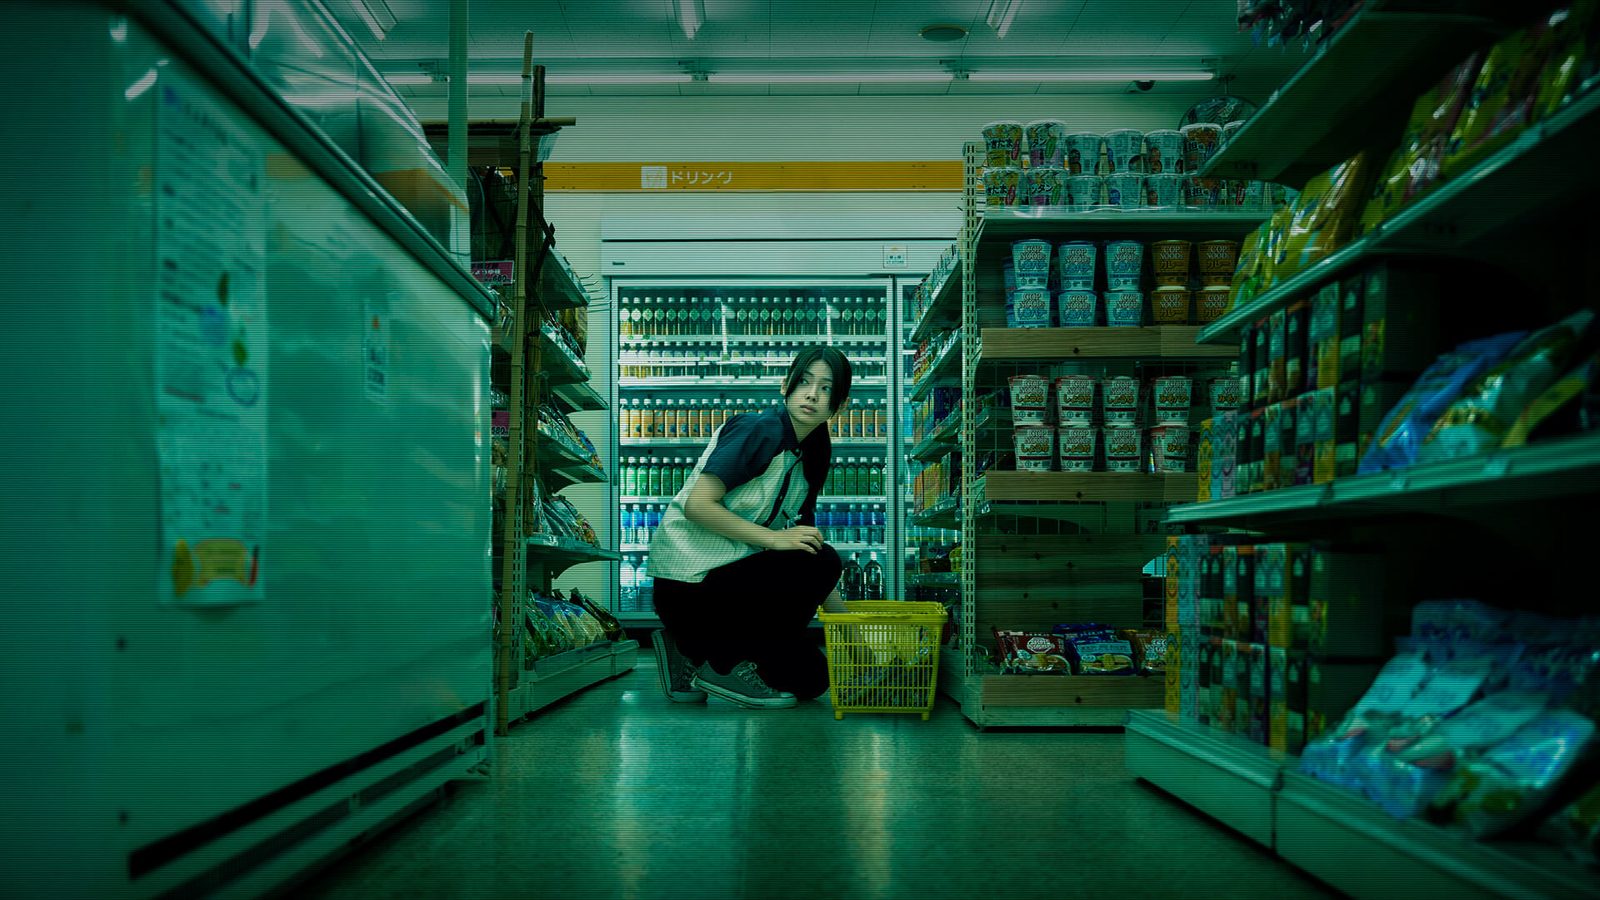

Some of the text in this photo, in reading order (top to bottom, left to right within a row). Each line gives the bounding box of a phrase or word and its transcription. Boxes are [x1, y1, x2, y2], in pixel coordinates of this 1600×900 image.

[671, 170, 733, 185] ドリンク
[1160, 260, 1186, 269] カレー
[1207, 260, 1234, 269] カレー
[1160, 308, 1185, 317] カレー
[1204, 308, 1223, 318] カレ
